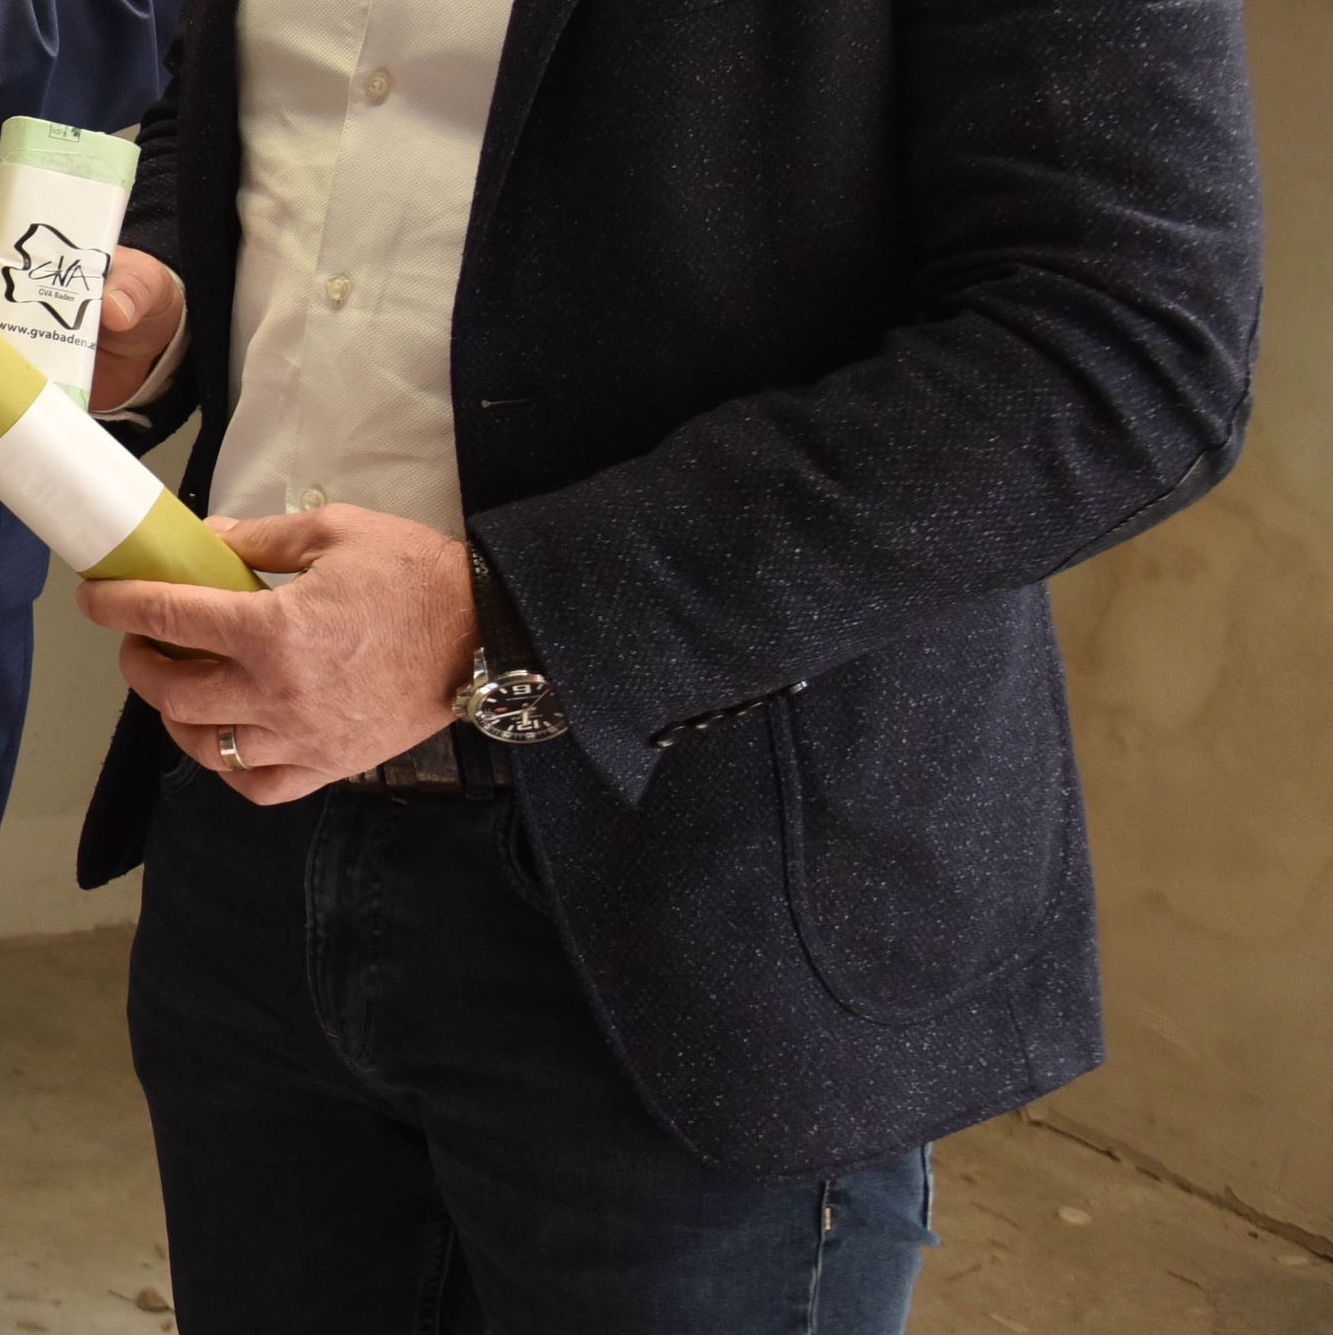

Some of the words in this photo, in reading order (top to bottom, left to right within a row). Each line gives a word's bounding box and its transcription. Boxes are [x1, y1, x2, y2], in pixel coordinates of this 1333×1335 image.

[28, 256, 102, 291] GVA
[38, 288, 53, 297] GVA
[54, 291, 75, 302] Baden
